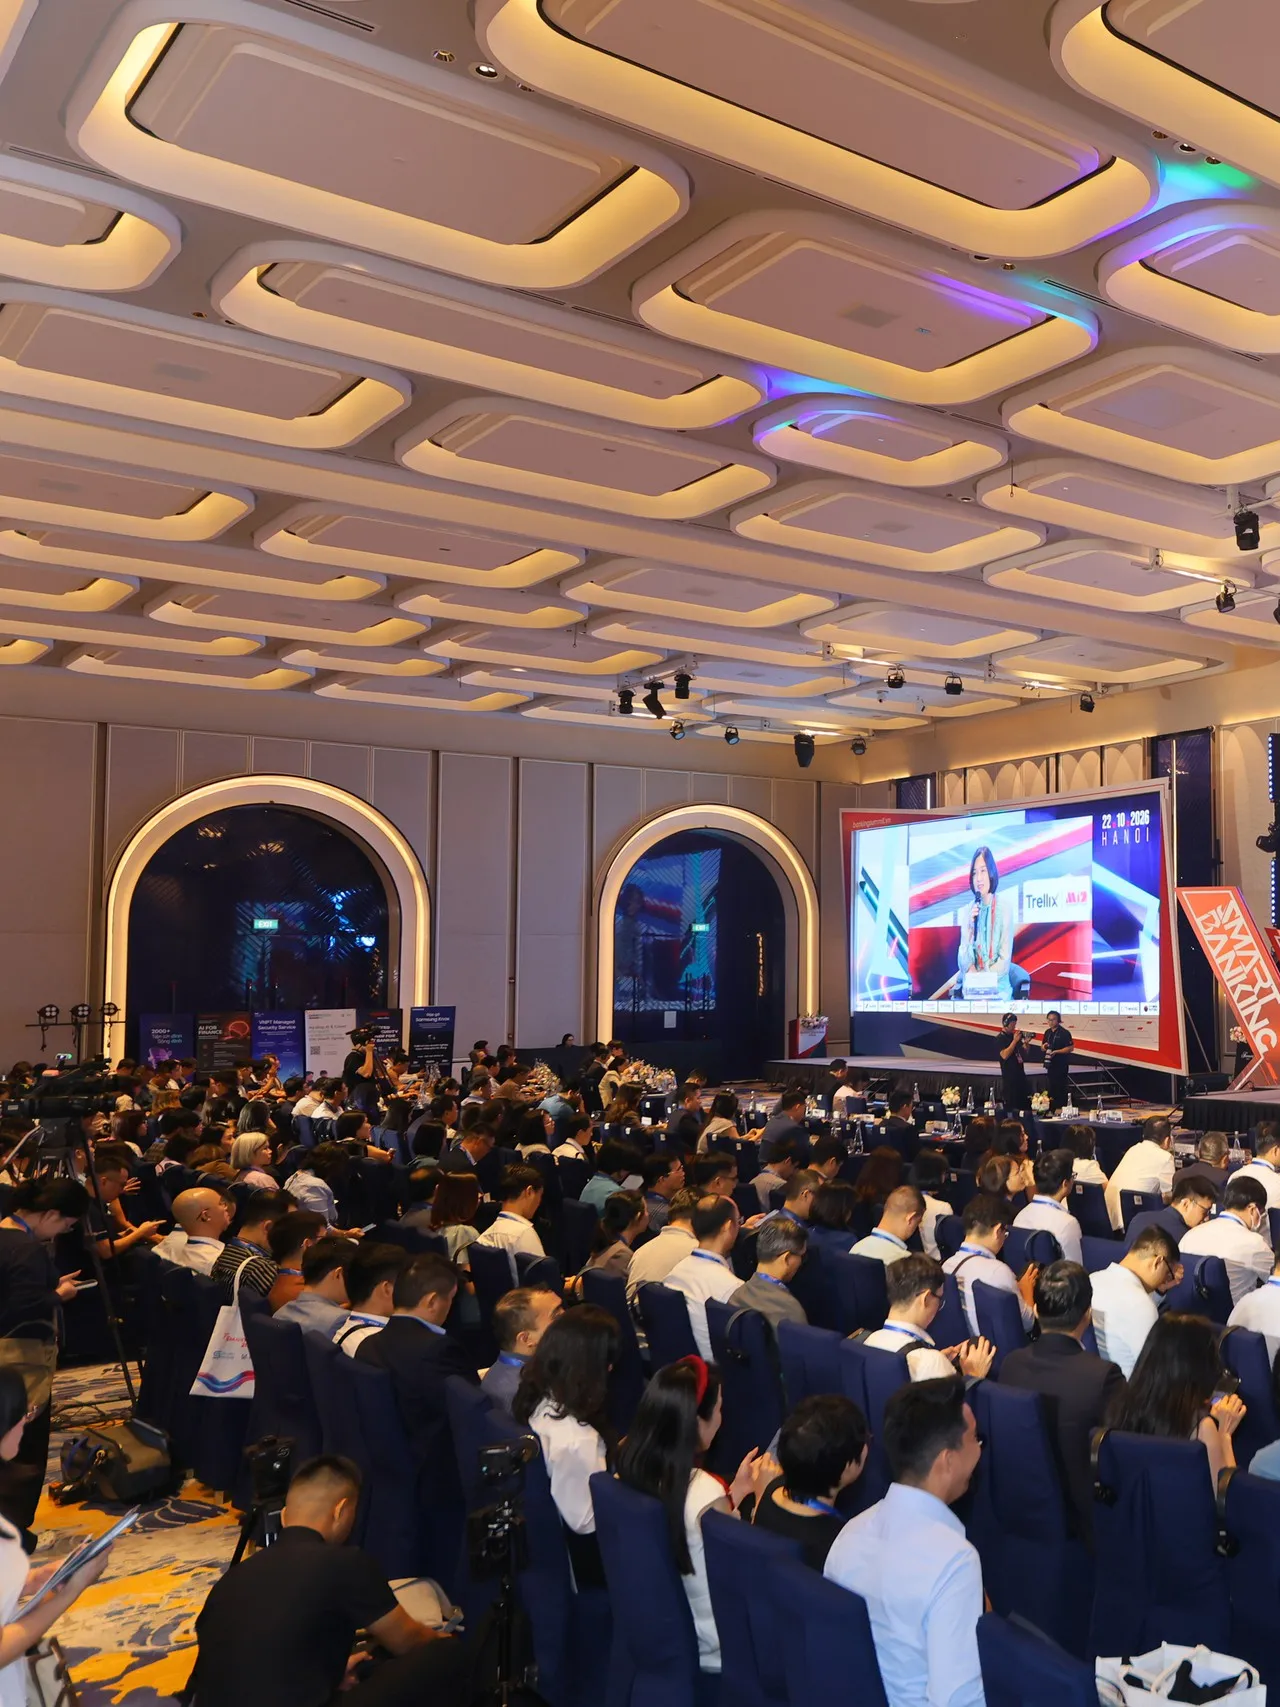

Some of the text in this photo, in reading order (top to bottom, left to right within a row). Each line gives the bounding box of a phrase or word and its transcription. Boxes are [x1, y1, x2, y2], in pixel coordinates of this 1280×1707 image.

[1101, 827, 1150, 847] HANOI
[1026, 893, 1059, 908] Trellix
[1199, 909, 1278, 1053] BANKING
